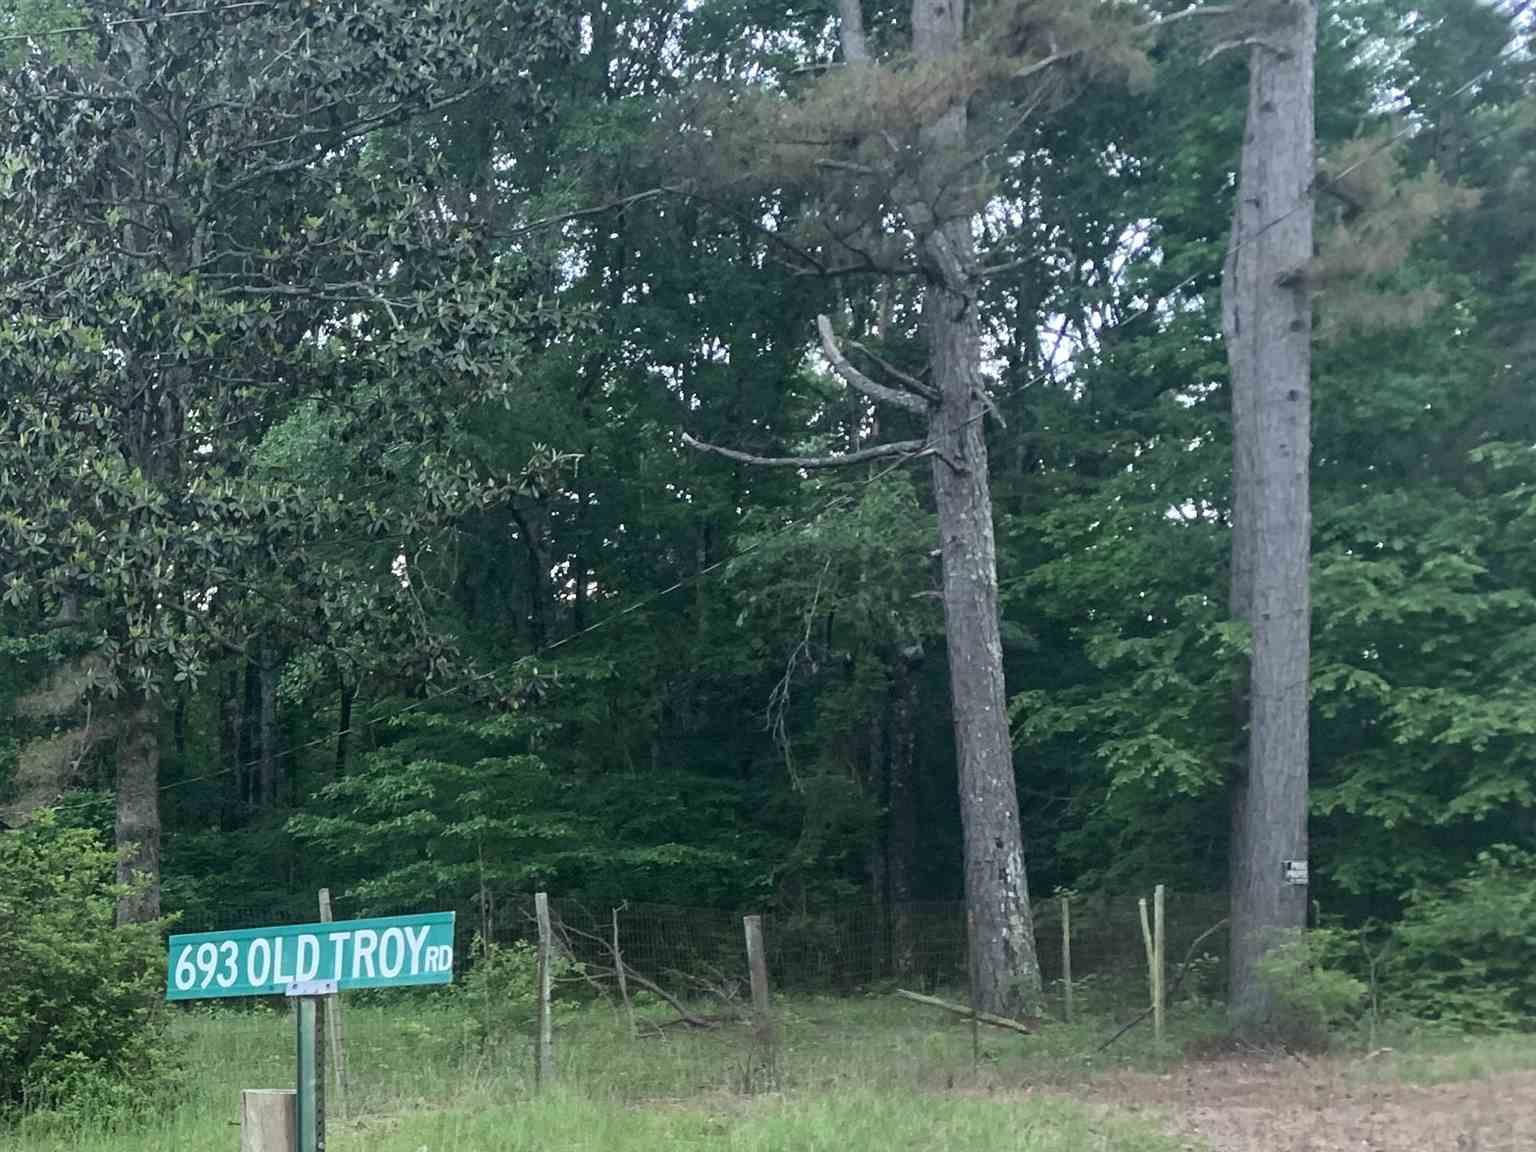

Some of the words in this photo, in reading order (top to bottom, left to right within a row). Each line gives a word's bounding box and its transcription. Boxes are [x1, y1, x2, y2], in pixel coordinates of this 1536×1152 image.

[175, 940, 239, 990] 693
[247, 934, 320, 987] OLD
[329, 925, 432, 981] TROY
[425, 945, 453, 971] RD
